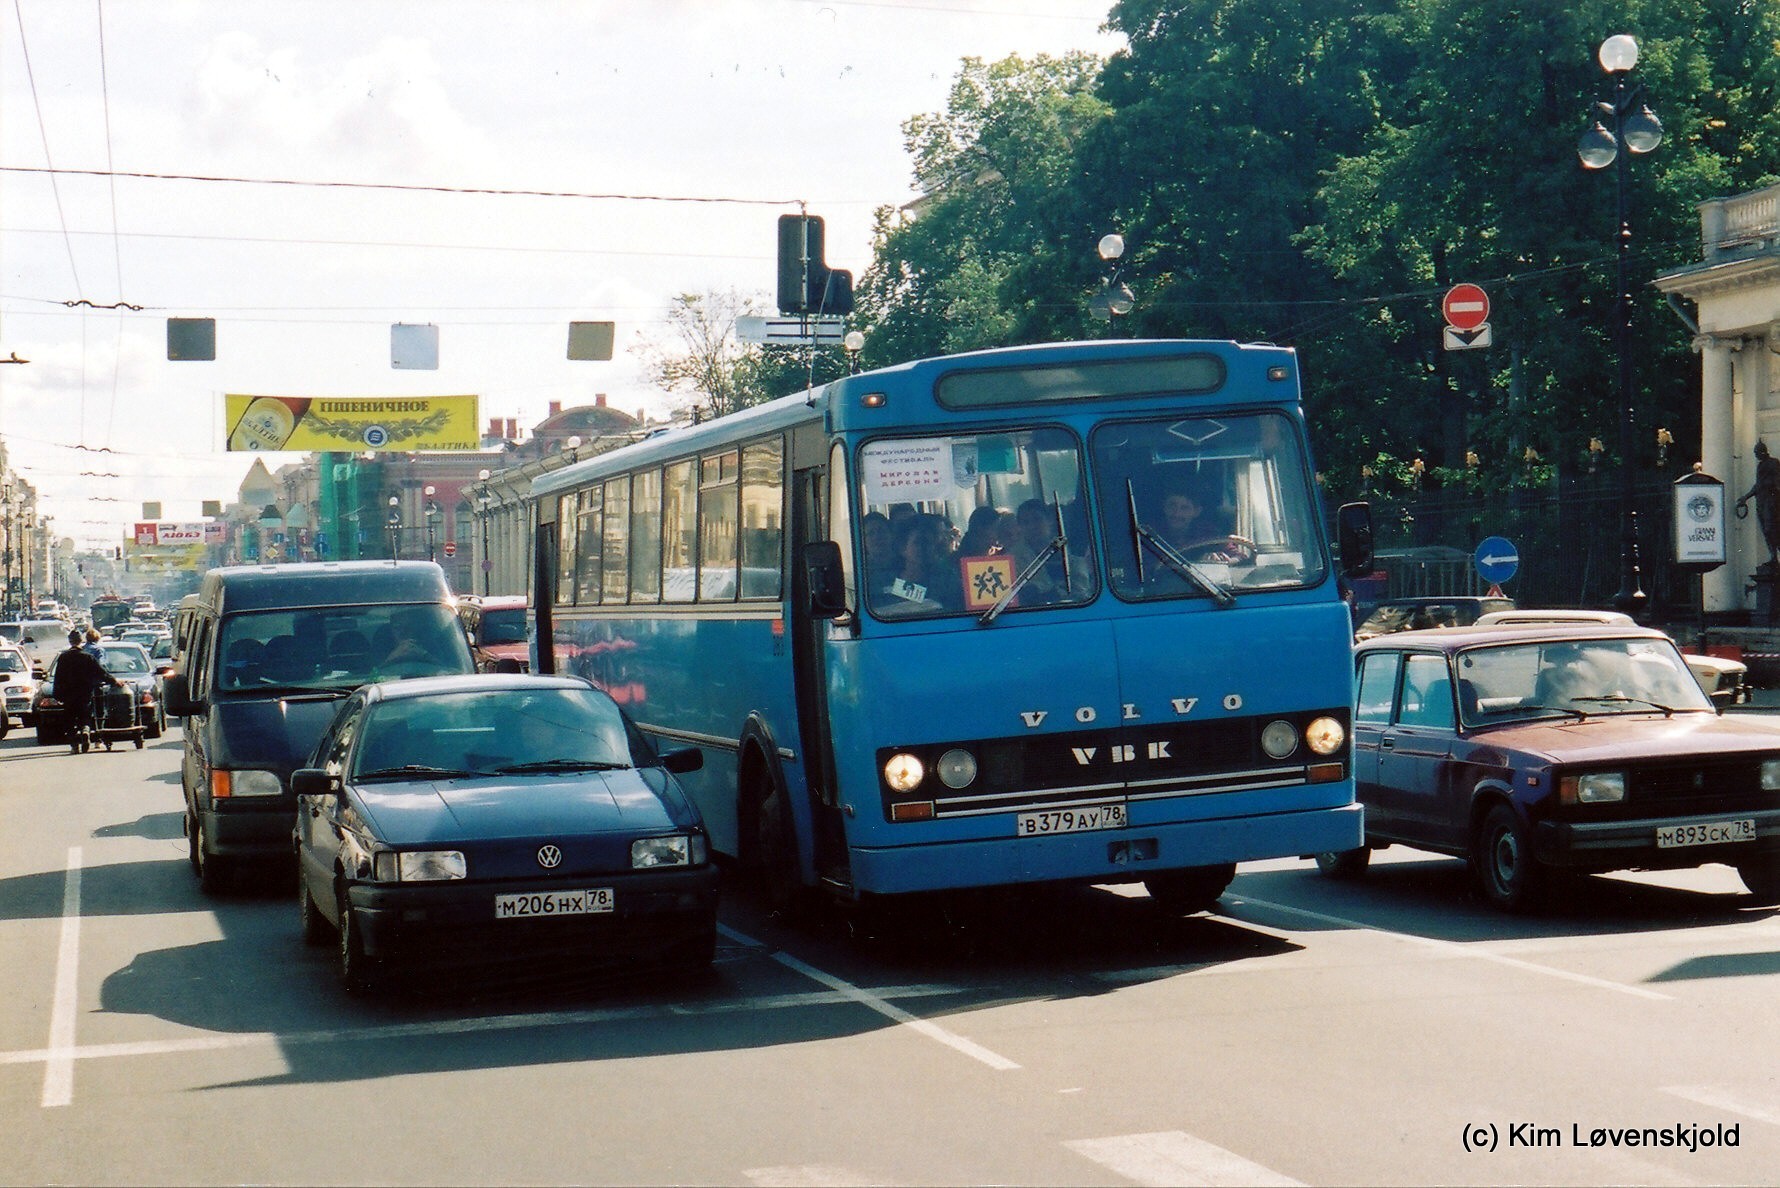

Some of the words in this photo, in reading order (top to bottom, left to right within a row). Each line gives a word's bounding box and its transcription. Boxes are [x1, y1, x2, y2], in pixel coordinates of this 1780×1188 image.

[319, 400, 430, 413] ПШЕНИЧНОЕ
[1020, 694, 1243, 728] VOLVO
[1072, 741, 1172, 765] VBK
[1026, 812, 1098, 833] В379АУ
[1103, 807, 1121, 821] 78
[1663, 826, 1730, 845] М893СК
[1734, 821, 1750, 834] 78
[503, 895, 583, 915] М206НХ
[588, 891, 607, 905] 78
